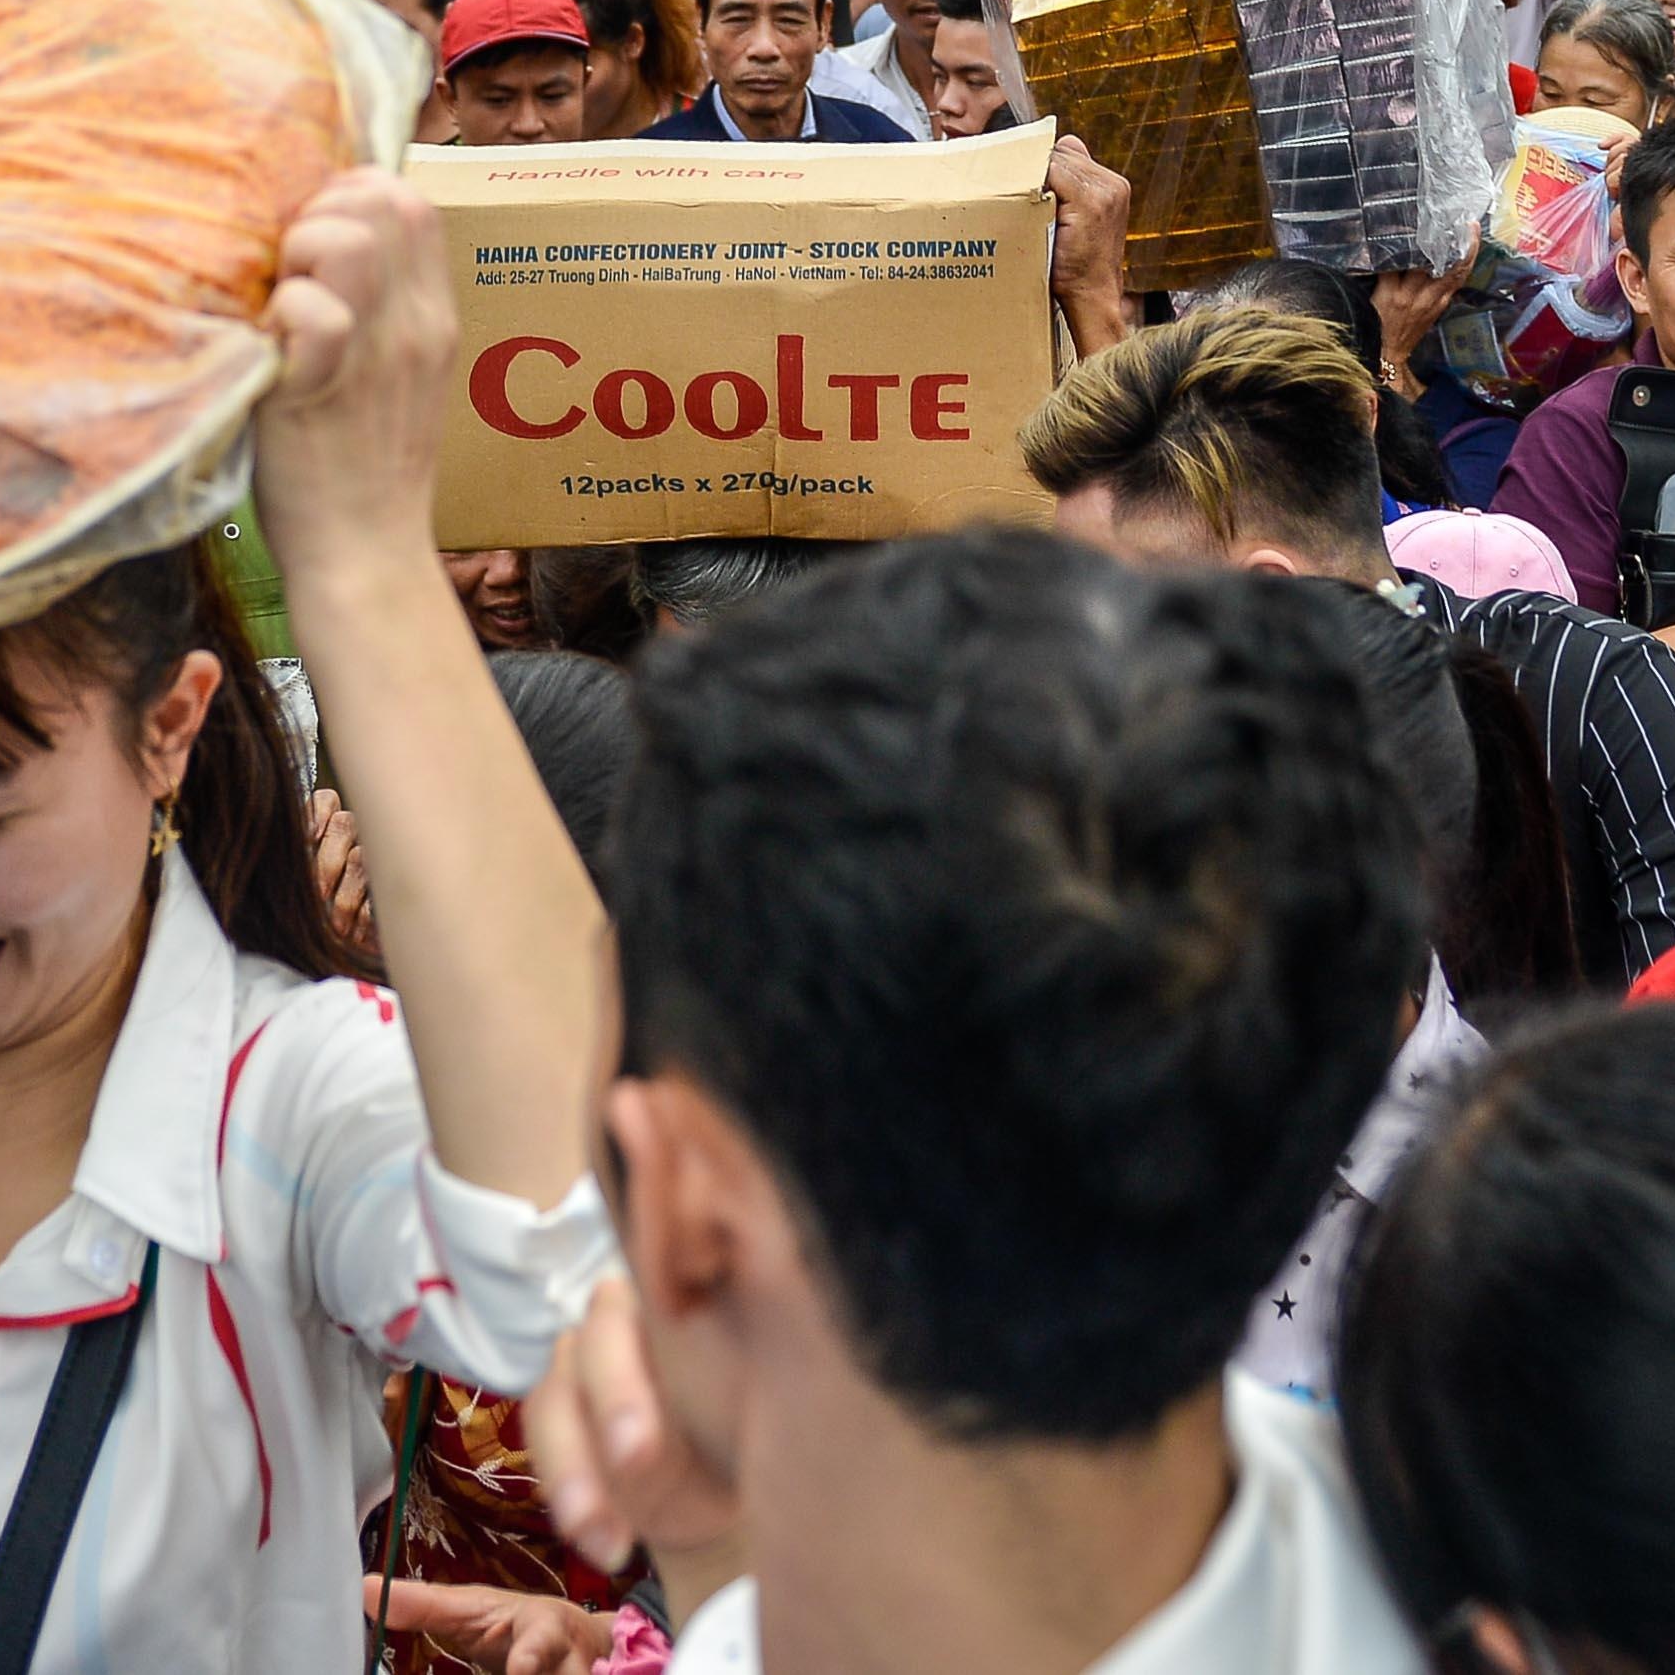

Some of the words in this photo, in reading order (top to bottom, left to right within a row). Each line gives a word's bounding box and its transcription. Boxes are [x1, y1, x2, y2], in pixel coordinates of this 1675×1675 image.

[487, 167, 620, 181] Handle
[635, 167, 709, 178] with
[724, 169, 805, 180] care
[476, 245, 538, 263] HAIHA
[545, 243, 717, 263] CONFECTIONERY
[724, 241, 788, 260] JOINT
[809, 241, 879, 258] STOCK
[888, 240, 997, 258] COMPANY
[476, 271, 506, 285] Add:
[510, 269, 545, 284] 25-27
[548, 269, 595, 286] Truong
[599, 268, 629, 283] Dinh
[735, 267, 776, 281] HaNoi
[789, 266, 846, 280] VietNam
[859, 266, 883, 280] Tel:
[888, 265, 994, 280] 84-24.38632041
[559, 472, 685, 496] 12packs
[694, 479, 712, 495] x
[721, 470, 875, 499] 270g/pack
